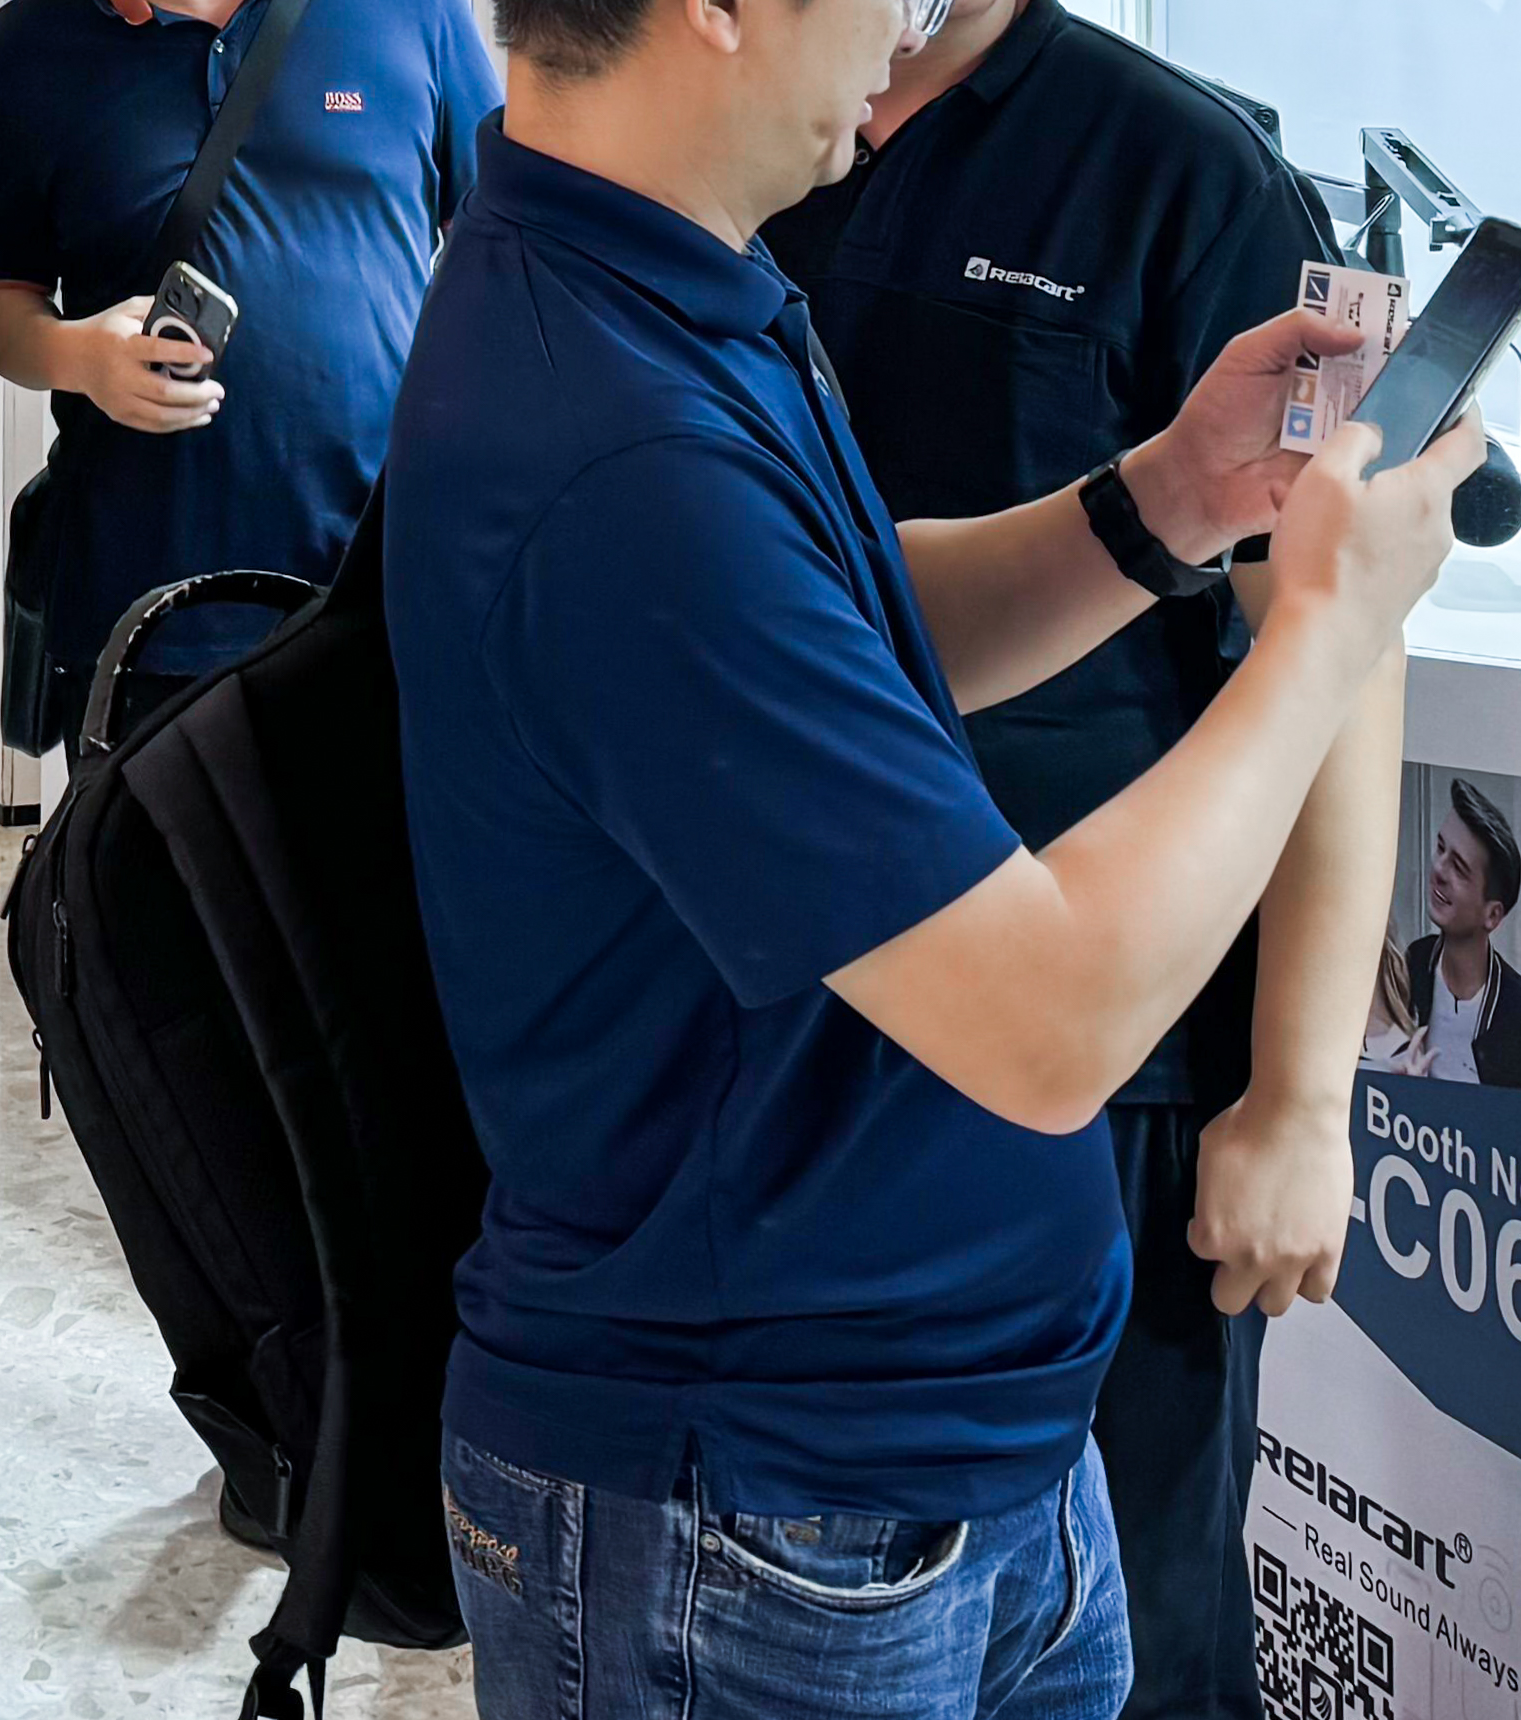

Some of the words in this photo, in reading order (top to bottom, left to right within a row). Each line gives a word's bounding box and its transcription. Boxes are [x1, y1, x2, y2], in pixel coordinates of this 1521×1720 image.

[1366, 1084, 1477, 1185] Booth
[1304, 1522, 1353, 1581] Real
[1359, 1561, 1431, 1633] Sound
[1436, 1613, 1519, 1692] Always
